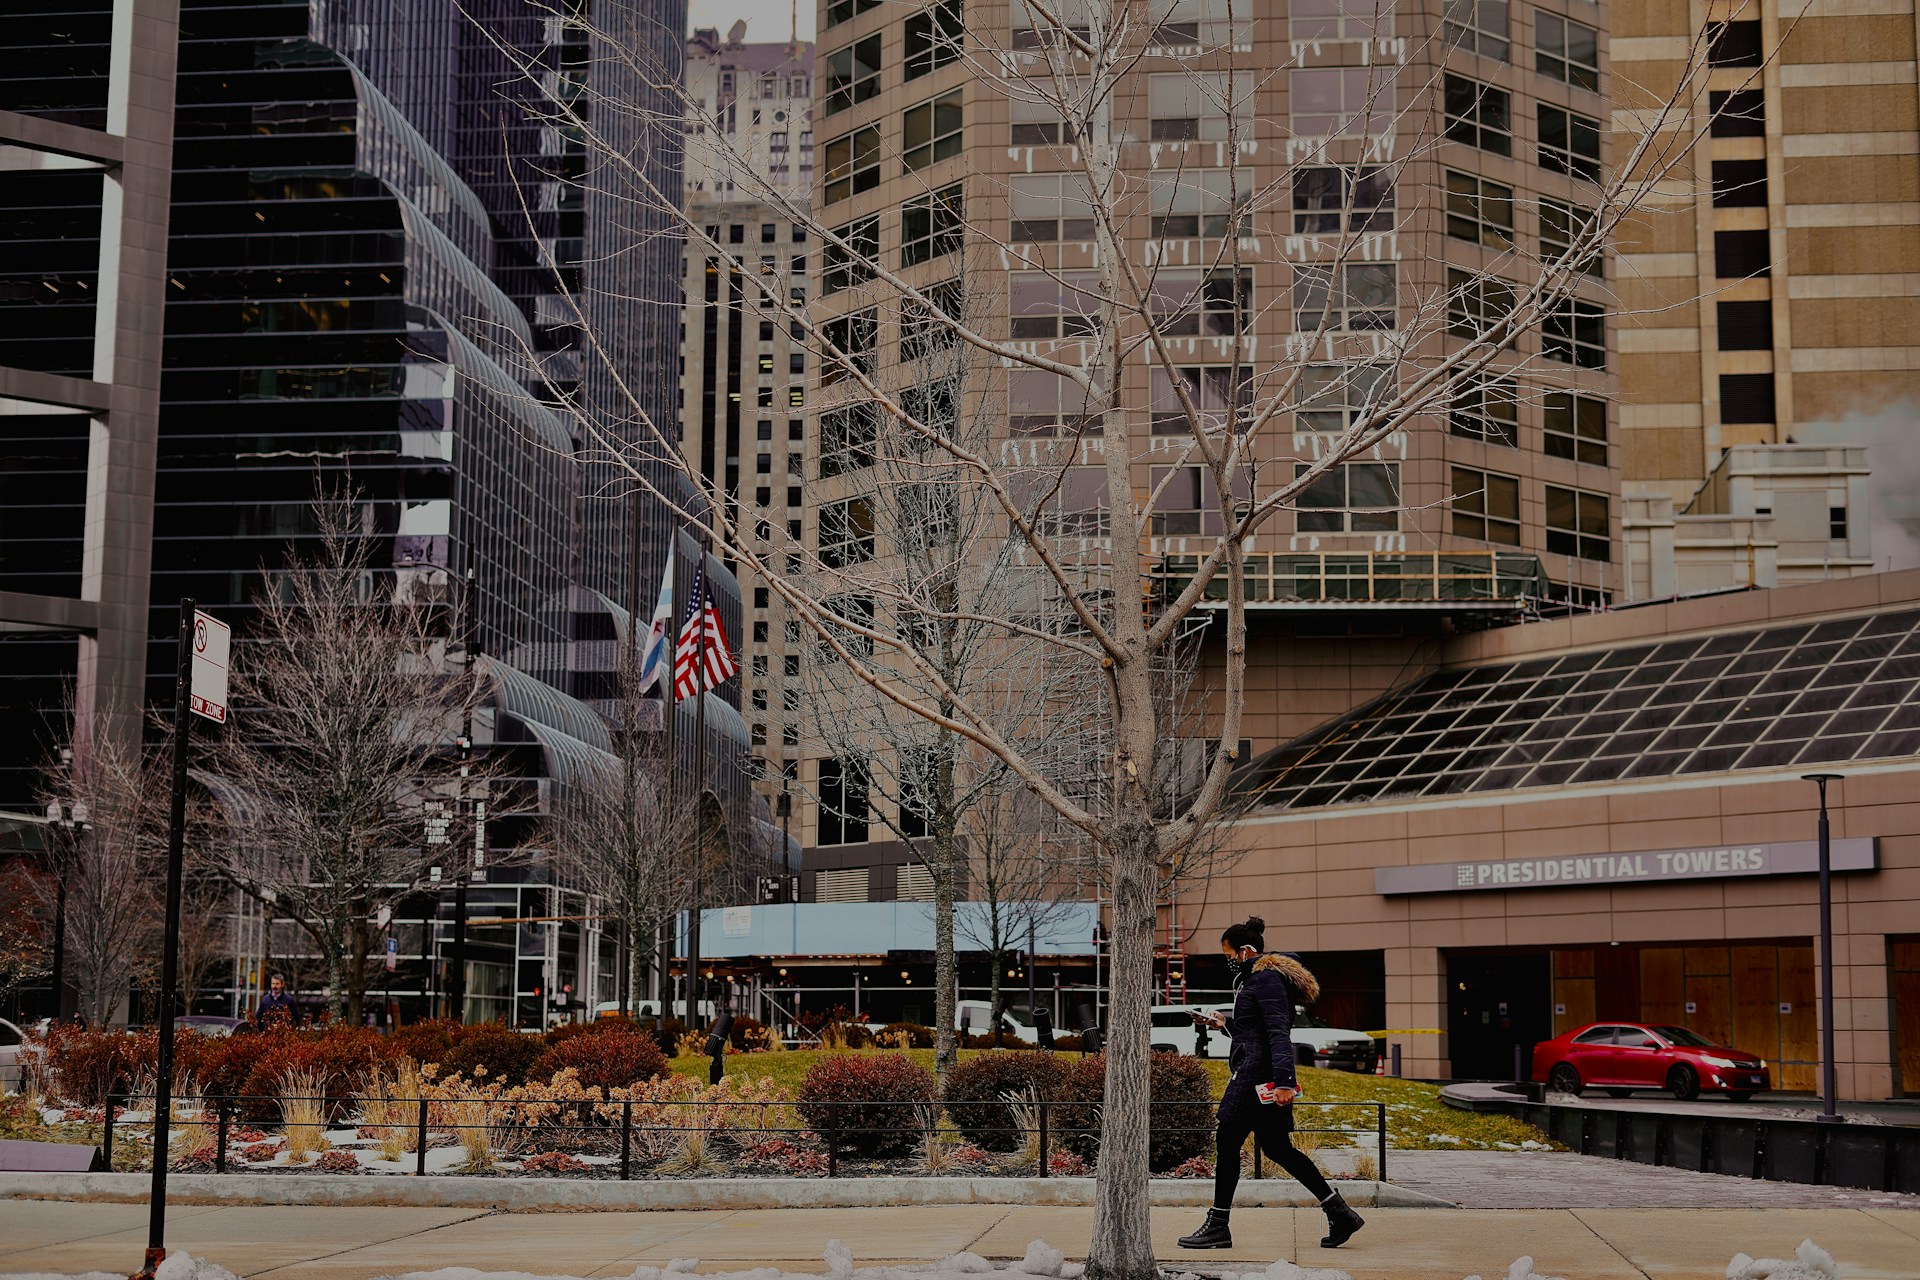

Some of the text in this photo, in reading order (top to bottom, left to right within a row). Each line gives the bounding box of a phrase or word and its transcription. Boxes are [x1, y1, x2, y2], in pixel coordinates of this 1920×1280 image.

[190, 695, 222, 720] TOW ZONE
[1477, 848, 1763, 884] PRESIDENTIAL TOWERS
